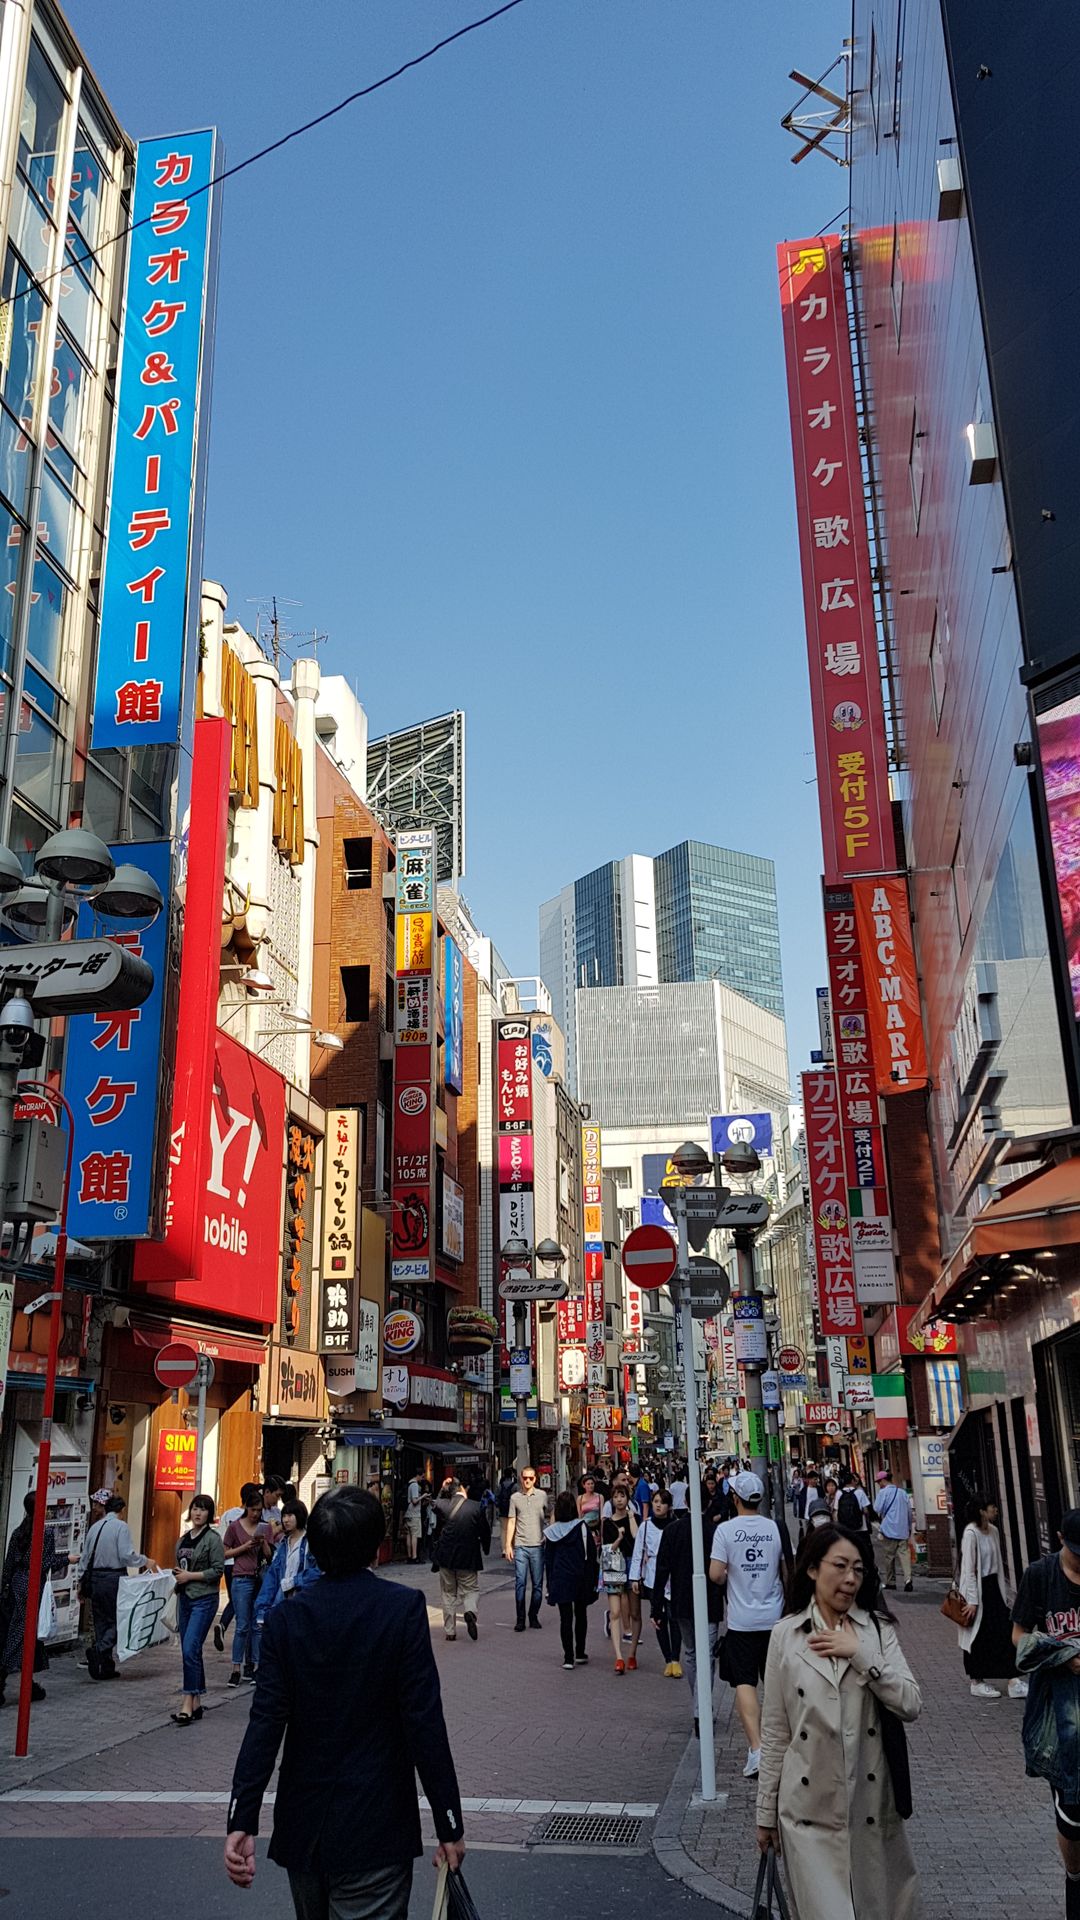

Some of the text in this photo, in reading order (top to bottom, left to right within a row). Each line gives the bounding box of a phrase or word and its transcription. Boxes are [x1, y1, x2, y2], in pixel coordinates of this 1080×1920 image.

[115, 152, 192, 725] カラオケ&パーティー館
[800, 294, 861, 677] カラオケ歌広場
[838, 751, 870, 857] 受付5F
[405, 857, 425, 900] 麻雀
[0, 952, 112, 981] センター街
[832, 912, 862, 1006] カラオケ
[78, 934, 143, 1204] オケ館
[515, 1045, 529, 1098] お好み焼
[841, 1042, 873, 1124] 歌広場
[402, 1091, 423, 1103] BURGER
[501, 1069, 515, 1117] もんじゃ
[19, 1101, 48, 1112] HYDRANT
[403, 1096, 424, 1109] KING
[809, 1075, 846, 1196] カラオケ
[206, 1100, 262, 1209] Y!
[585, 1129, 599, 1184] カラオケ
[853, 1129, 873, 1186] 受付2F
[397, 1168, 427, 1180] 105席
[510, 1183, 522, 1192] 4F
[586, 1194, 600, 1202] 3F
[722, 1202, 764, 1215] ター街
[853, 1221, 883, 1230] Miami
[392, 1264, 429, 1276] センタービル
[819, 1233, 857, 1327] 歌広場
[385, 1319, 415, 1333] BURGER
[385, 1326, 415, 1342] KING
[325, 1333, 350, 1347] B1F
[328, 1367, 356, 1378] SUSHI
[384, 1368, 406, 1384] すし
[165, 1434, 195, 1451] SIM
[923, 1455, 945, 1465] LOC
[734, 1530, 773, 1547] Dodgers
